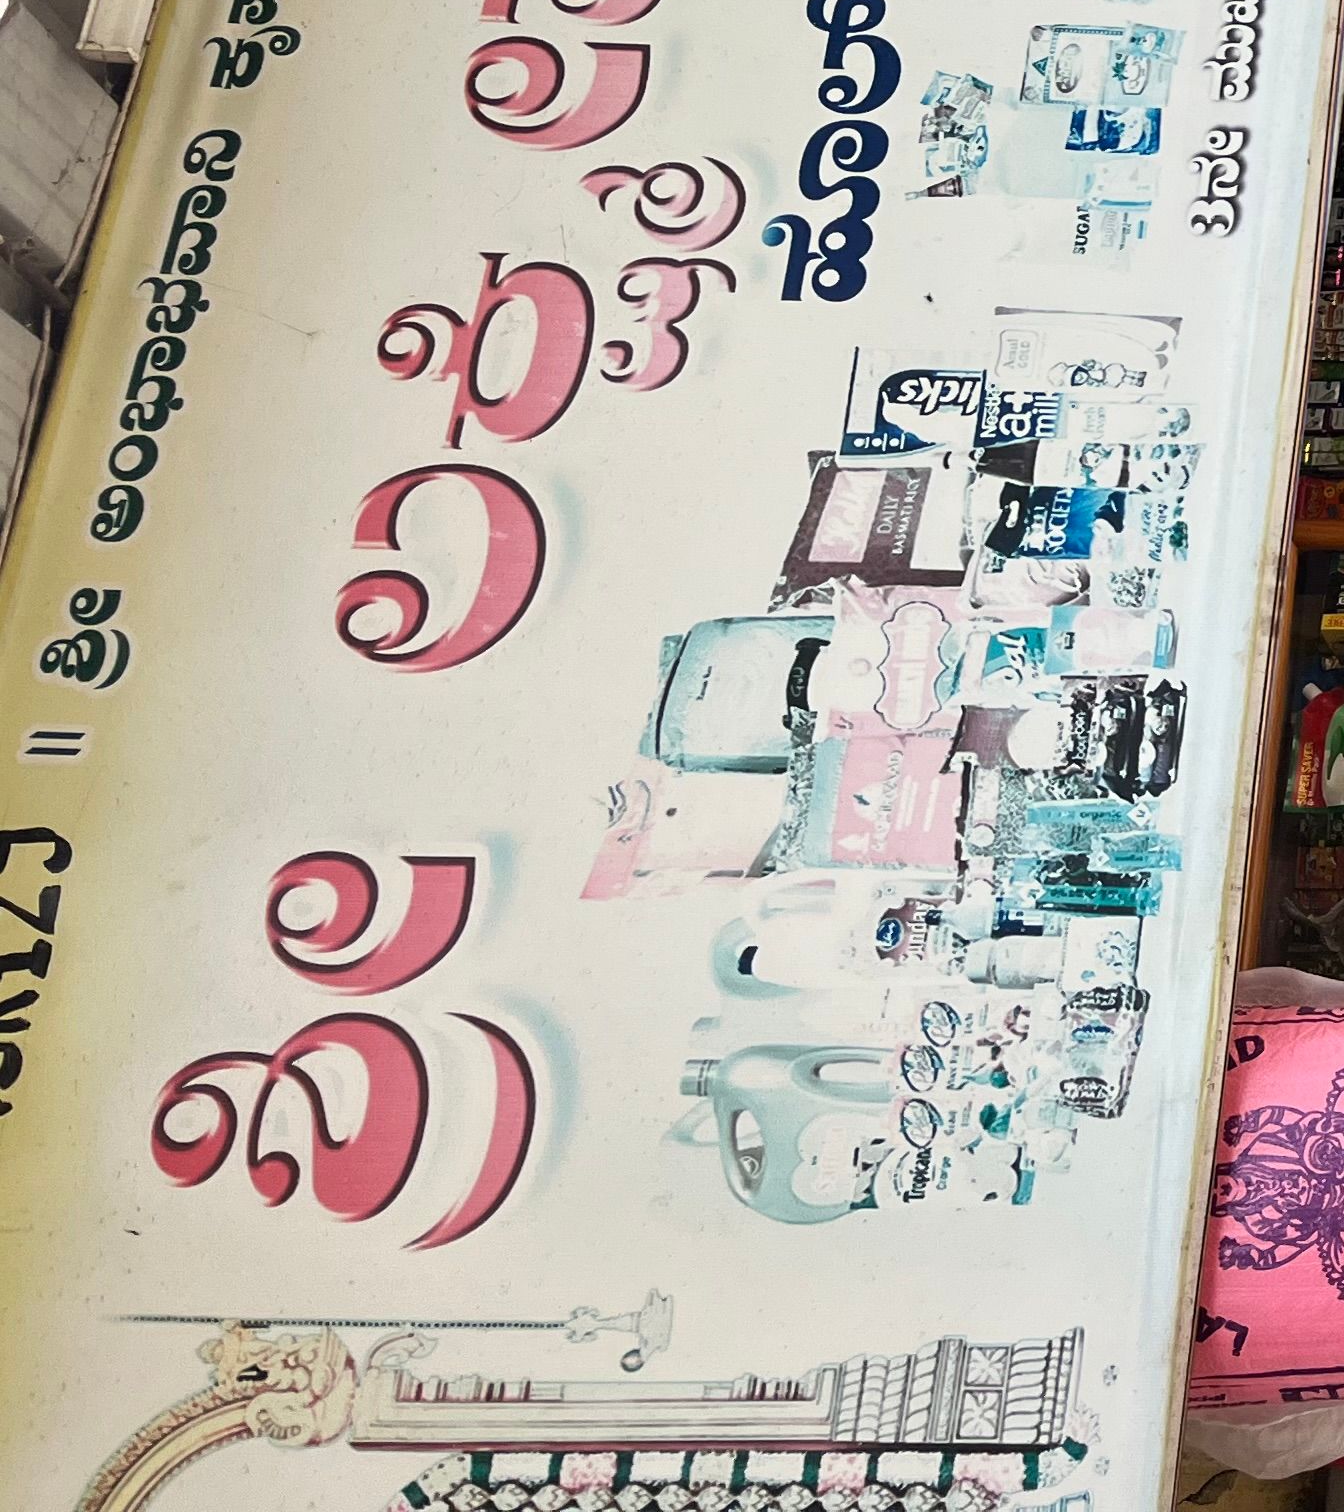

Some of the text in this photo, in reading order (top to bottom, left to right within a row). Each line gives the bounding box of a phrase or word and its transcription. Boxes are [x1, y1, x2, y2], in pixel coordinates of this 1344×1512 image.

[39, 589, 129, 688] ಶ್ರೀ
[87, 128, 242, 542] ಅಂಭಾಭವಾನಿ
[878, 495, 899, 533] DAILY
[151, 851, 536, 1250] ಶ್ರೀ
